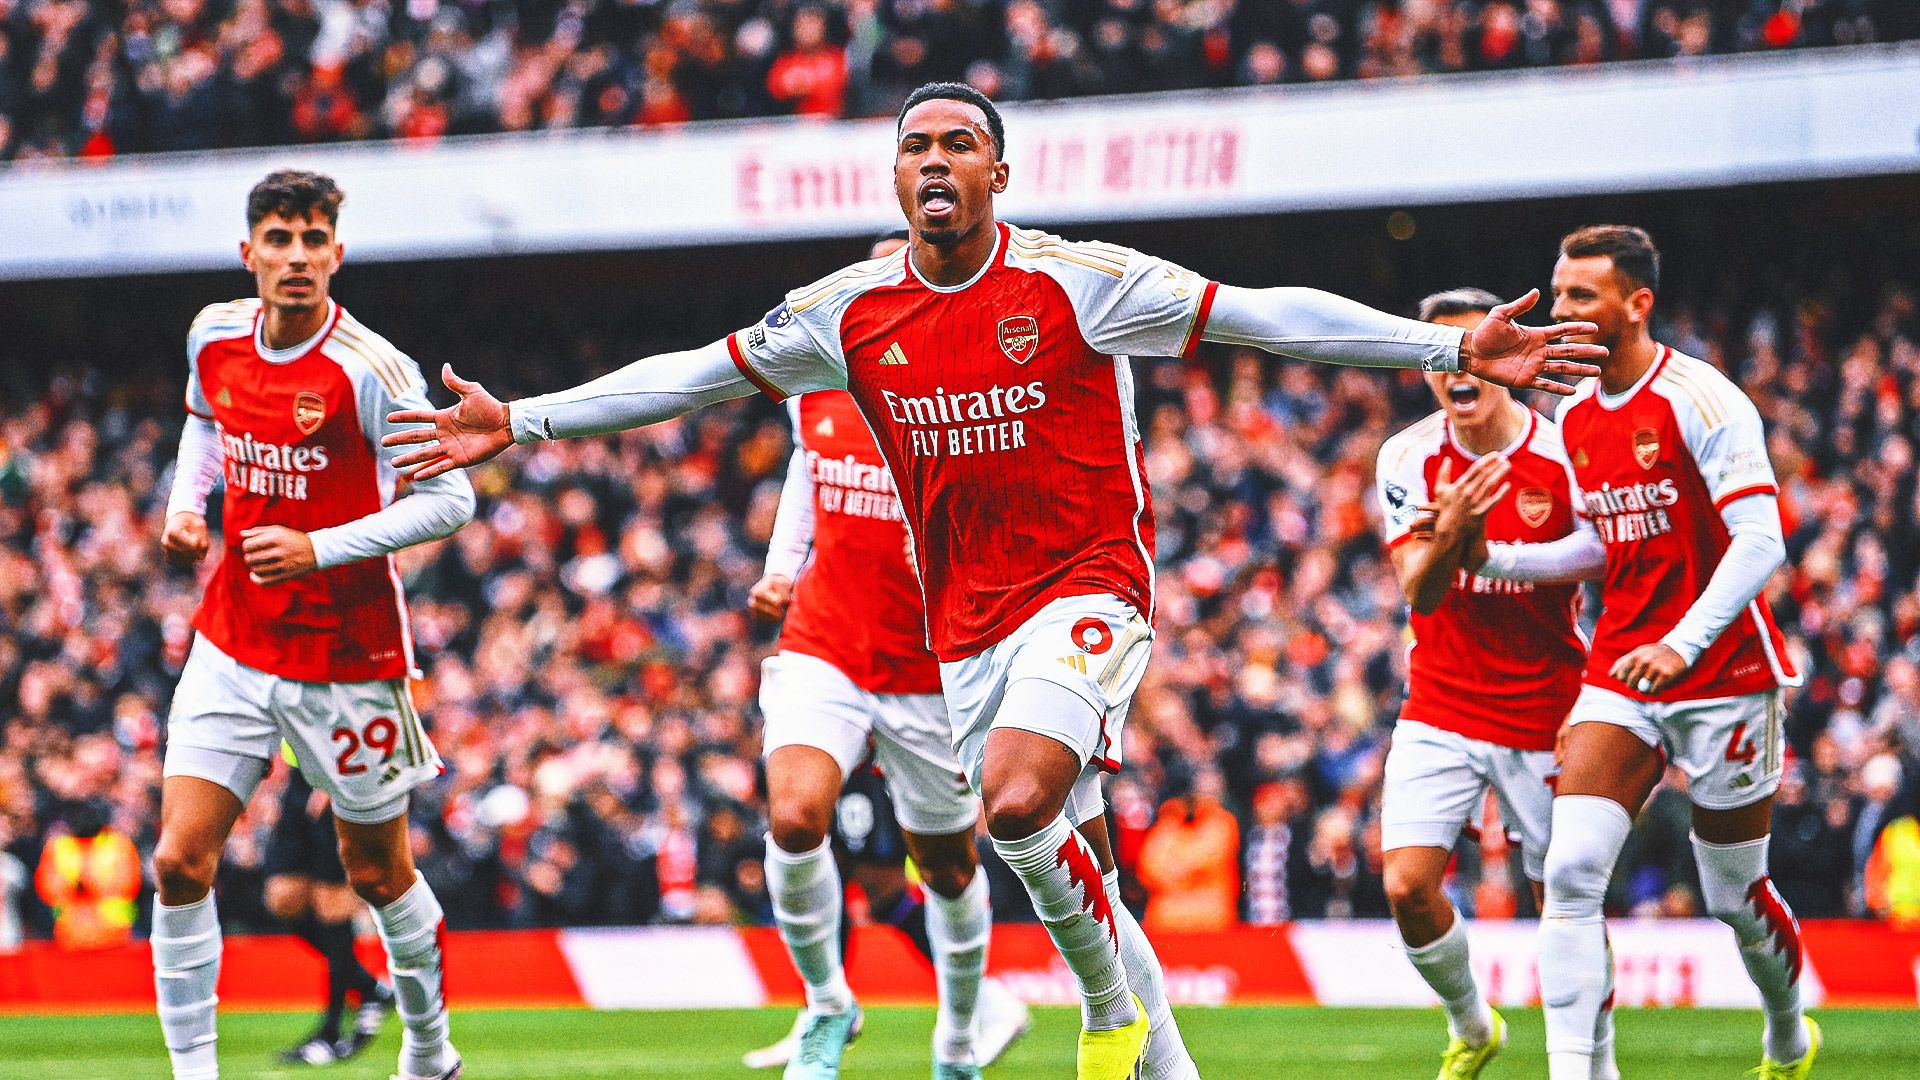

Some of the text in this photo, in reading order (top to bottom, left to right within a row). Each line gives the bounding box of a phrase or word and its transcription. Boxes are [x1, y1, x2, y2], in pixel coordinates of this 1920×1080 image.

[1003, 323, 1033, 335] Arsenal
[881, 381, 1046, 425] Emirates
[911, 420, 1027, 457] FLY BETTER
[248, 466, 308, 500] BETTER
[1616, 509, 1673, 543] BETTER
[331, 715, 399, 777] 29
[1724, 721, 1757, 764] 4
